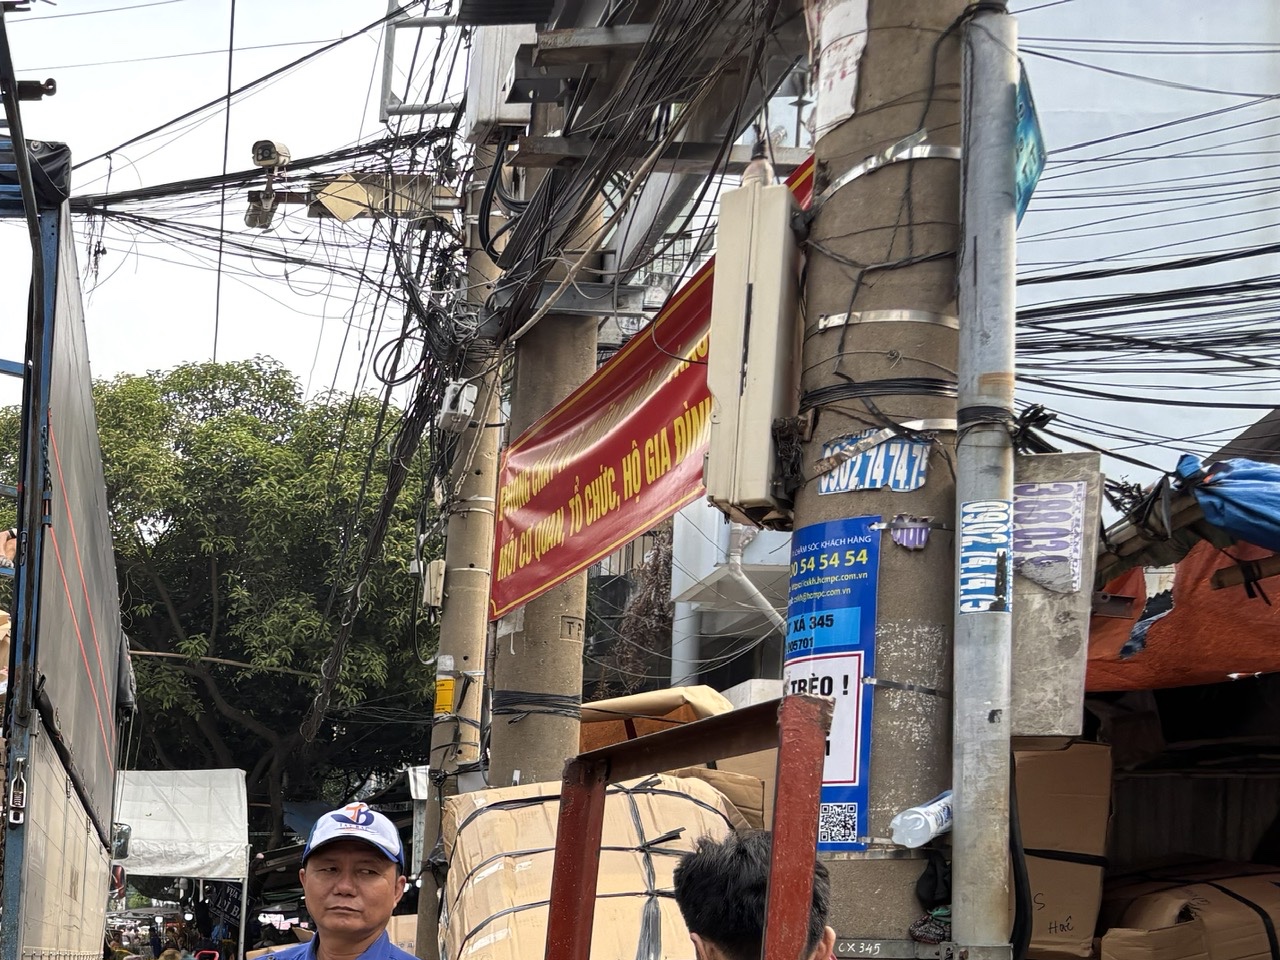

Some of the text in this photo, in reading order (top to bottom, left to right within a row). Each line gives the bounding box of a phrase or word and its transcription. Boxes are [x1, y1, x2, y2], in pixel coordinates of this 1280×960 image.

[569, 476, 584, 536] TỔ
[584, 465, 620, 526] CHỨC,
[622, 440, 641, 503] HỘ
[645, 427, 671, 485] GIA
[847, 535, 872, 545] HÀNG
[800, 556, 815, 575] 54
[819, 552, 840, 570] 54
[844, 548, 869, 567] 54
[793, 614, 806, 633] XÁ
[809, 614, 834, 630] 345
[842, 674, 849, 696] !
[859, 942, 881, 956] 345
